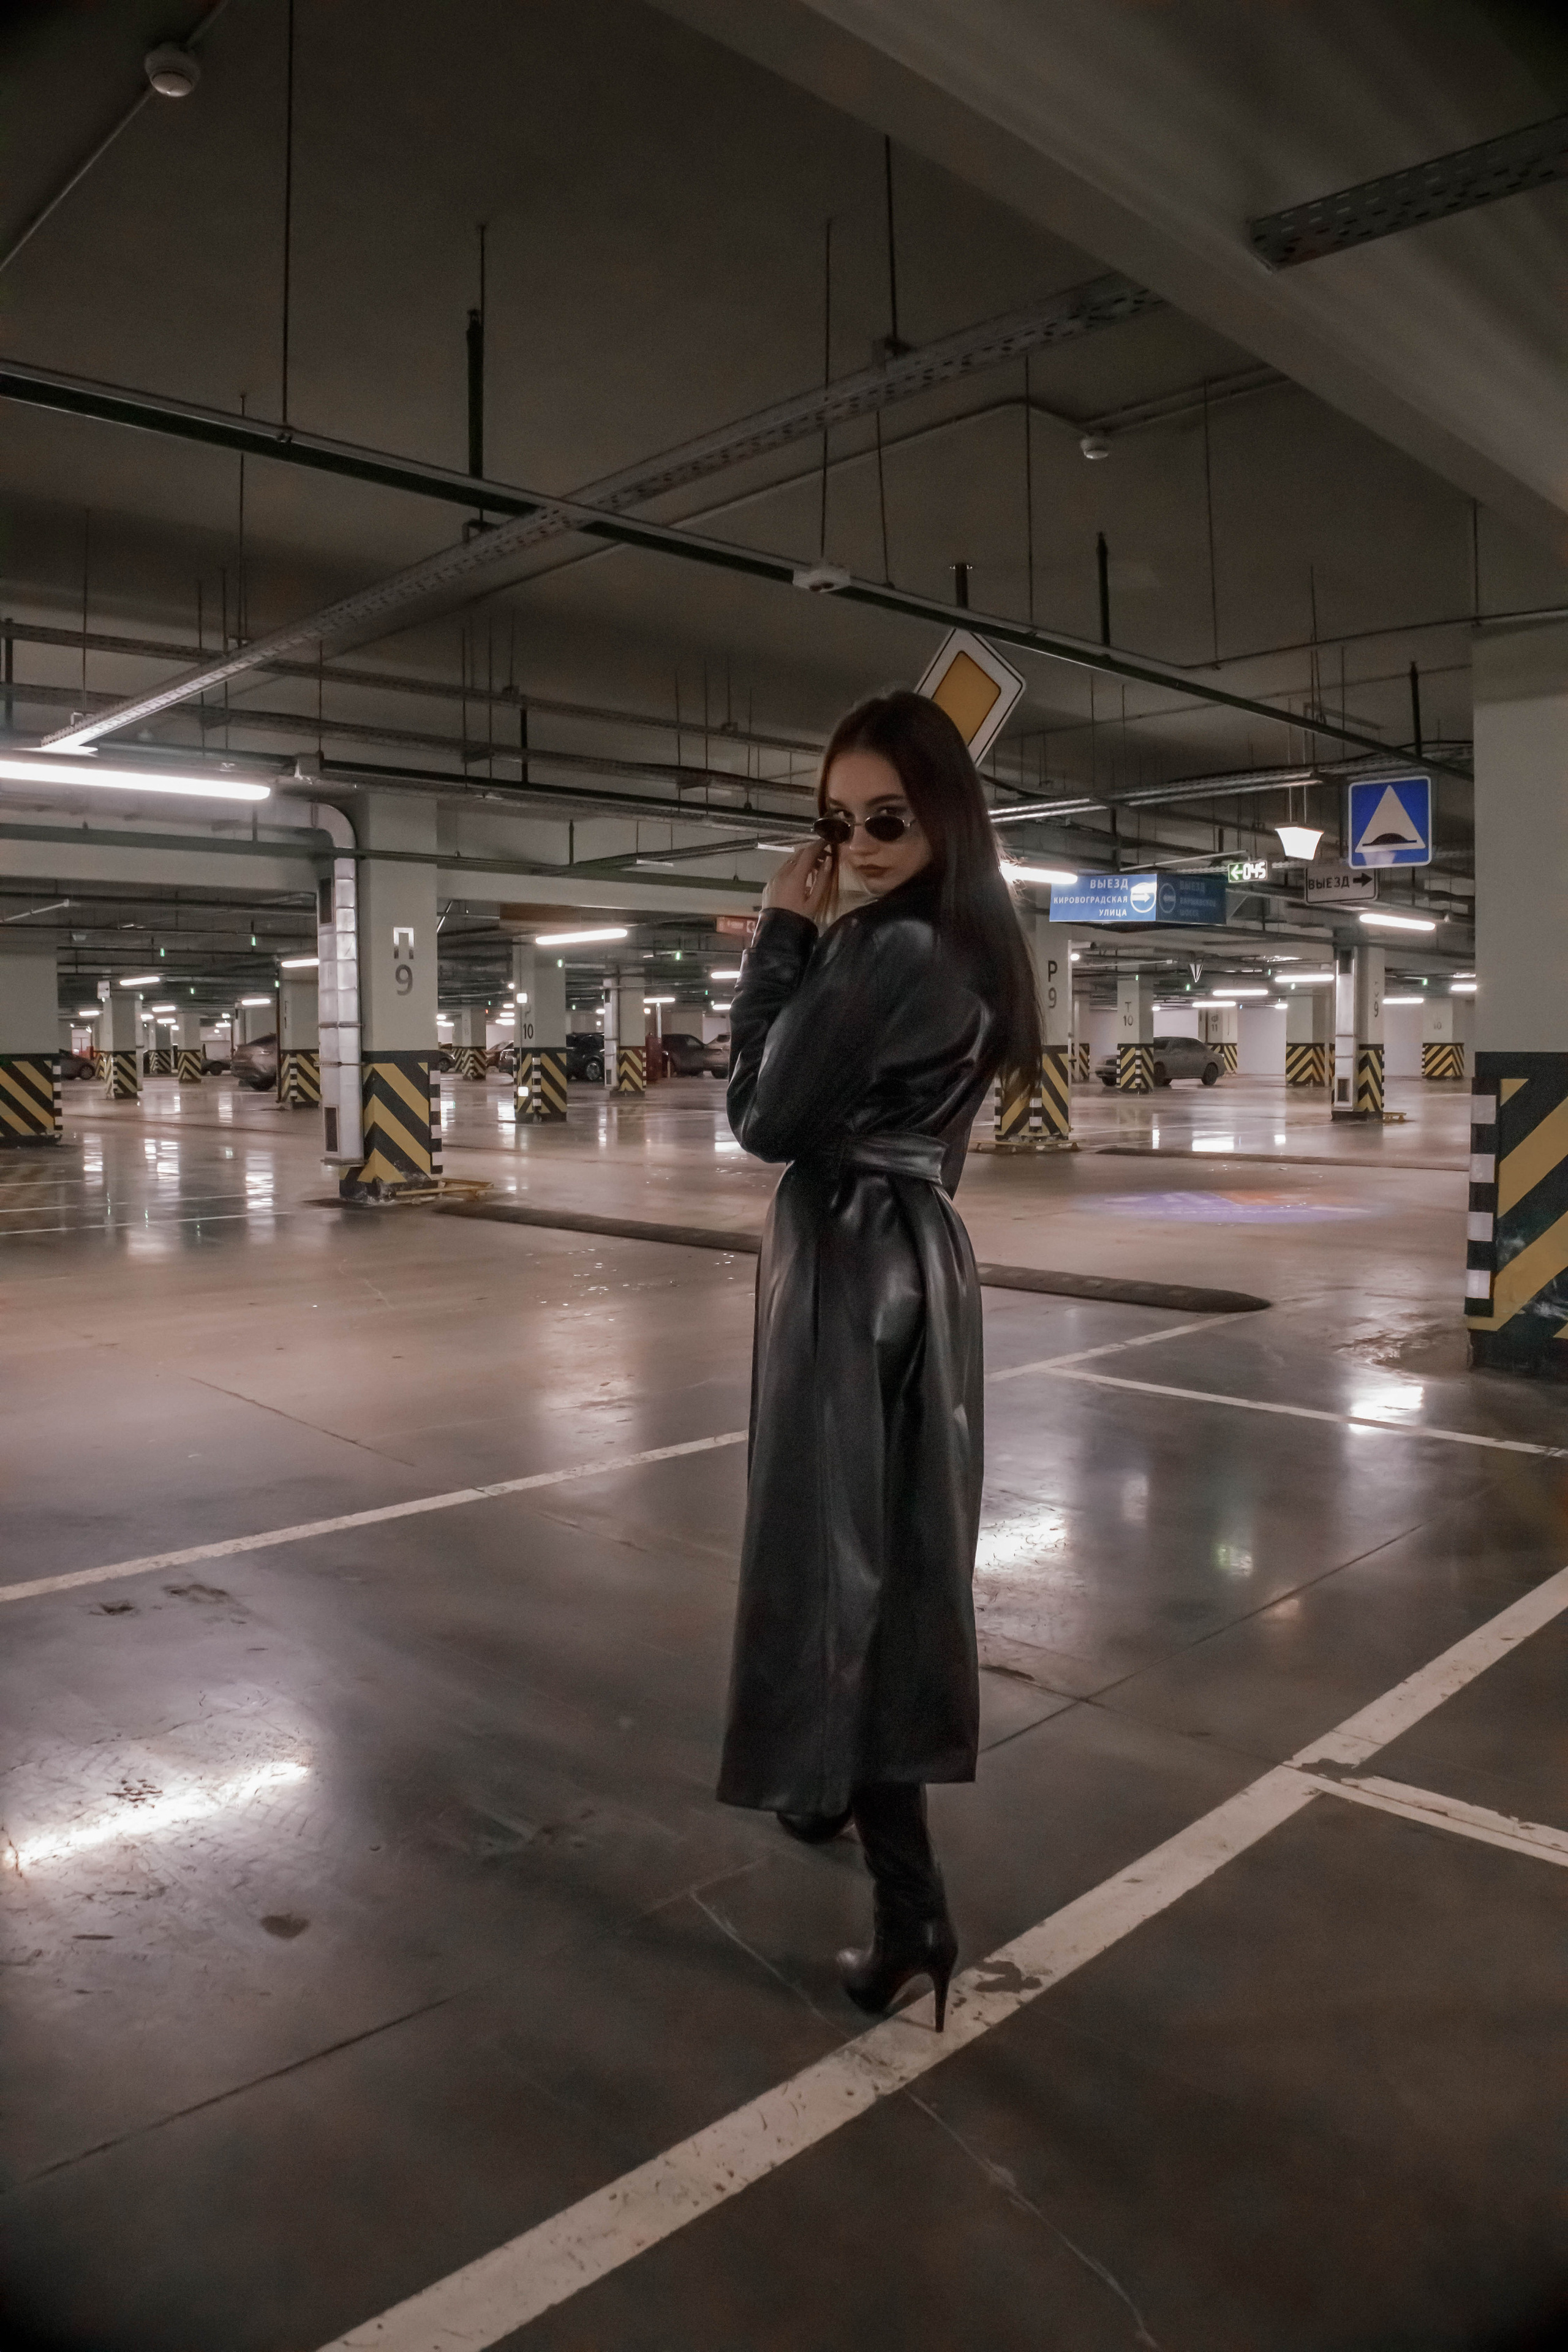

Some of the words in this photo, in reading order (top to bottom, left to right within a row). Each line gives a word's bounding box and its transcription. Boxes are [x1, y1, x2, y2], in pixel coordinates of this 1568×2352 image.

[1243, 862, 1266, 880] 045
[1090, 878, 1128, 890] ВЫЕЗД
[1308, 876, 1350, 890] ВЫЕЗД
[1054, 895, 1128, 905] КИРОВОГРАДСКАЯ
[1099, 908, 1127, 918] УЛИЦА
[393, 927, 415, 960] П
[395, 964, 413, 996] 9
[1048, 987, 1057, 1009] 9
[1374, 1001, 1379, 1018] 9
[1123, 1015, 1133, 1027] 10
[1211, 1023, 1218, 1032] 11
[523, 1023, 533, 1039] 10
